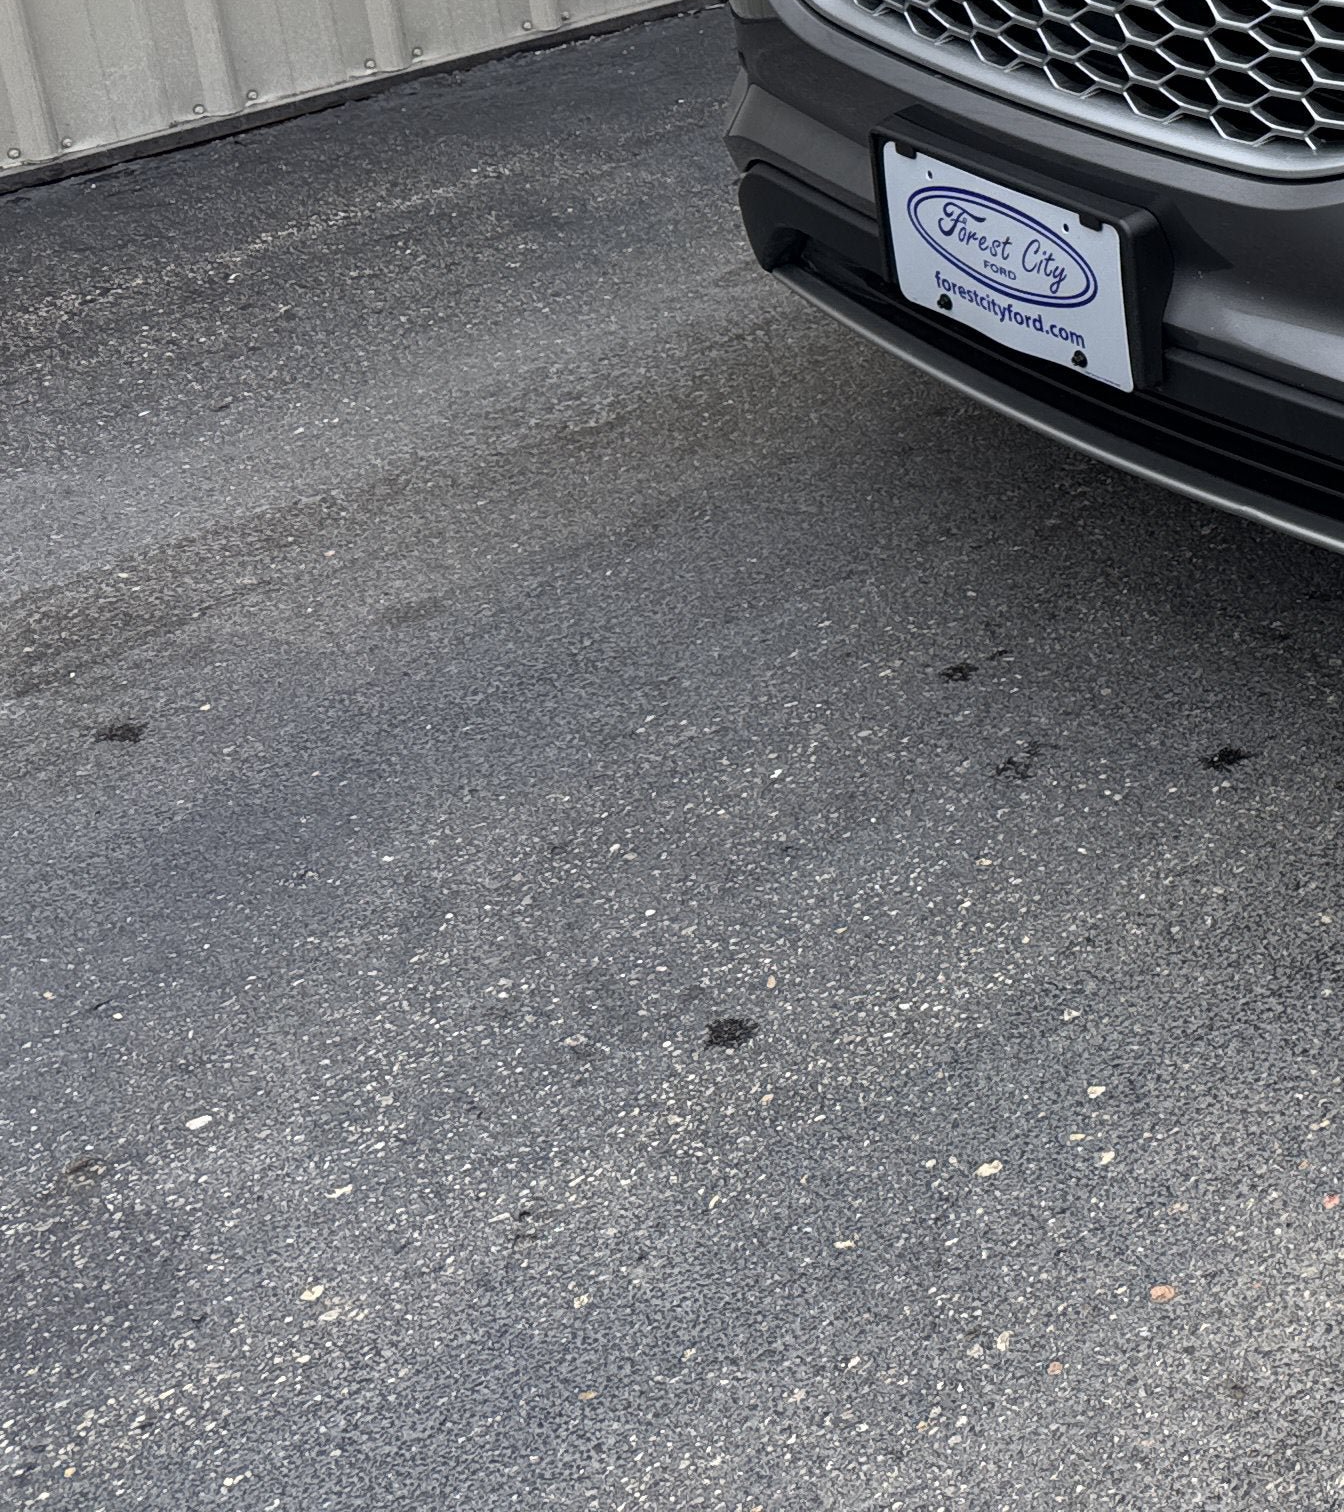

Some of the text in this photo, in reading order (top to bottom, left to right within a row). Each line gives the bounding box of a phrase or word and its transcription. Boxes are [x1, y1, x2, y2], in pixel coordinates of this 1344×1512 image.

[937, 201, 1068, 295] Forest City
[983, 259, 1017, 282] FORD
[935, 270, 1087, 350] forestcityford.com
